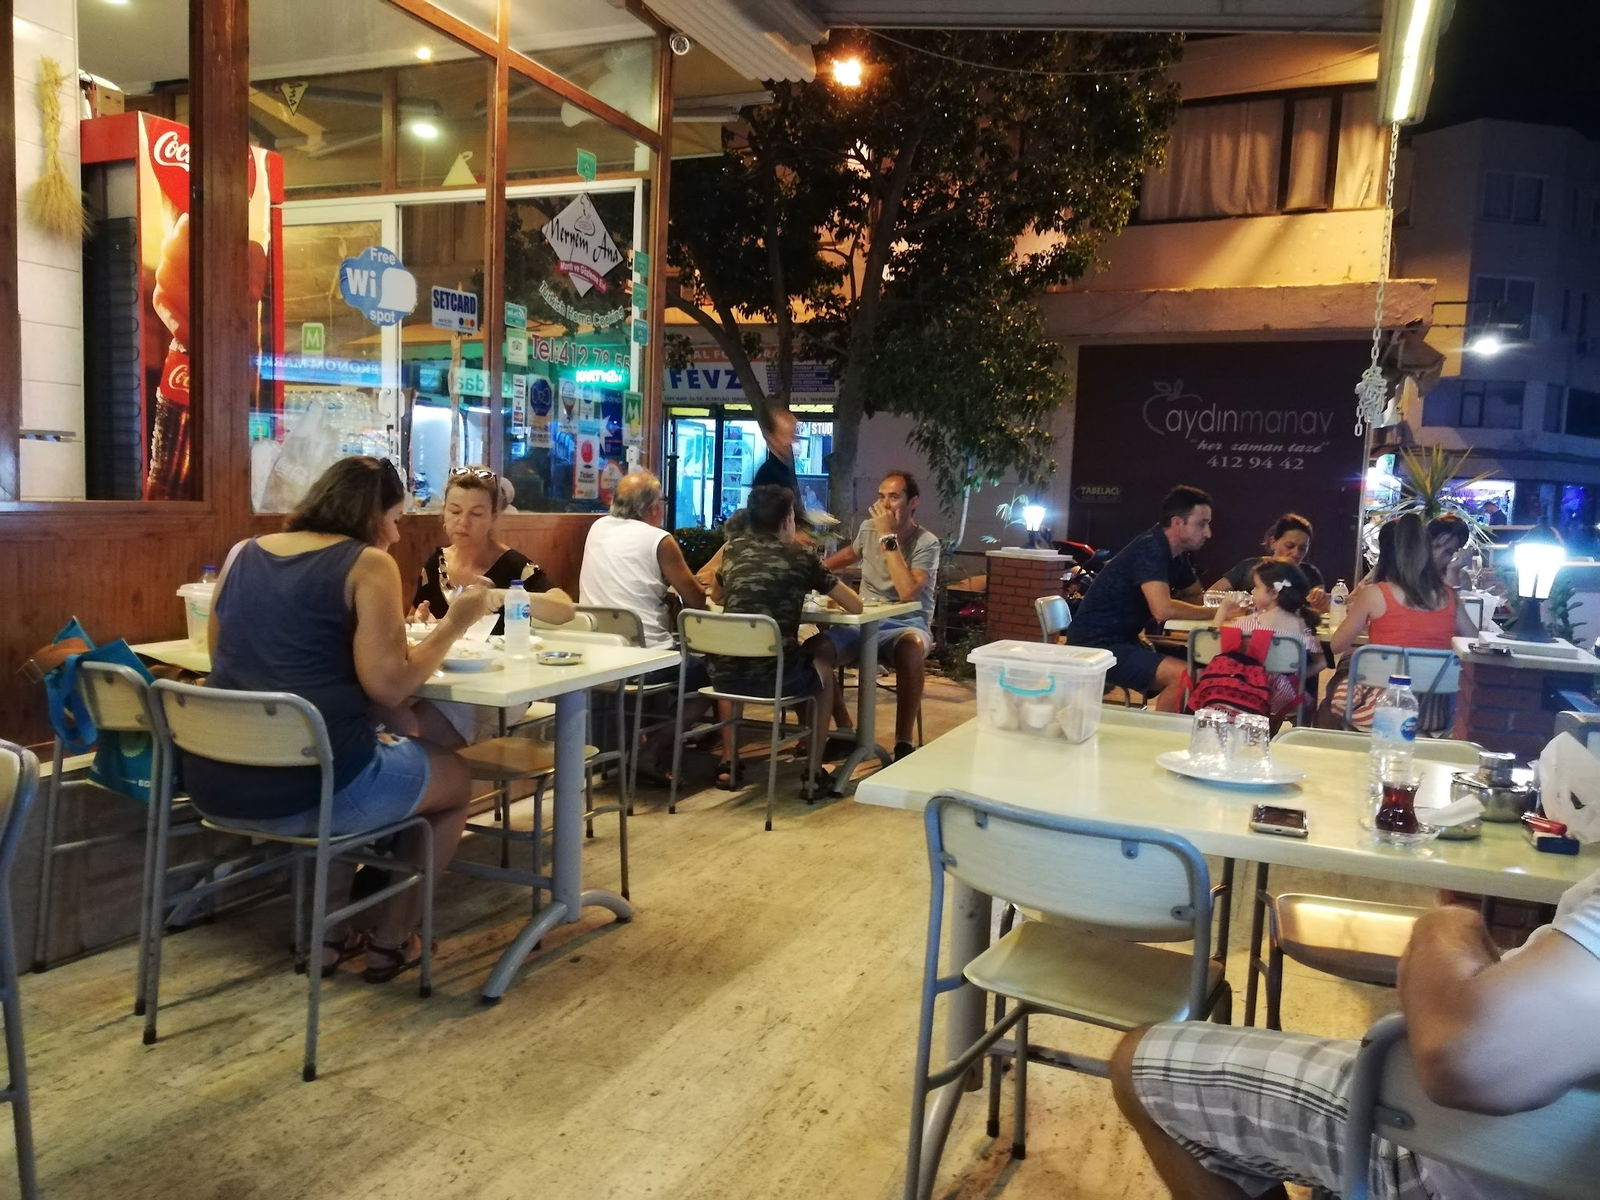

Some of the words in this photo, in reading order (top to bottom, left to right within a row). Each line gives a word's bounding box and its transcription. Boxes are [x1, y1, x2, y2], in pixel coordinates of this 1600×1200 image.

[153, 131, 190, 172] Coc
[544, 218, 589, 263] Meryem
[592, 232, 619, 263] Ana
[370, 247, 396, 265] Free
[346, 267, 377, 298] Wi
[433, 289, 477, 315] SETCARD
[539, 280, 567, 317] Turkish
[566, 305, 593, 325] Home
[592, 305, 625, 328] Cooking
[369, 309, 396, 325] spot
[592, 347, 610, 367] 78
[669, 369, 743, 390] FEVZ
[1230, 443, 1283, 453] zaman
[1206, 455, 1243, 468] 412
[1248, 456, 1273, 469] 94
[1279, 457, 1305, 470] 42
